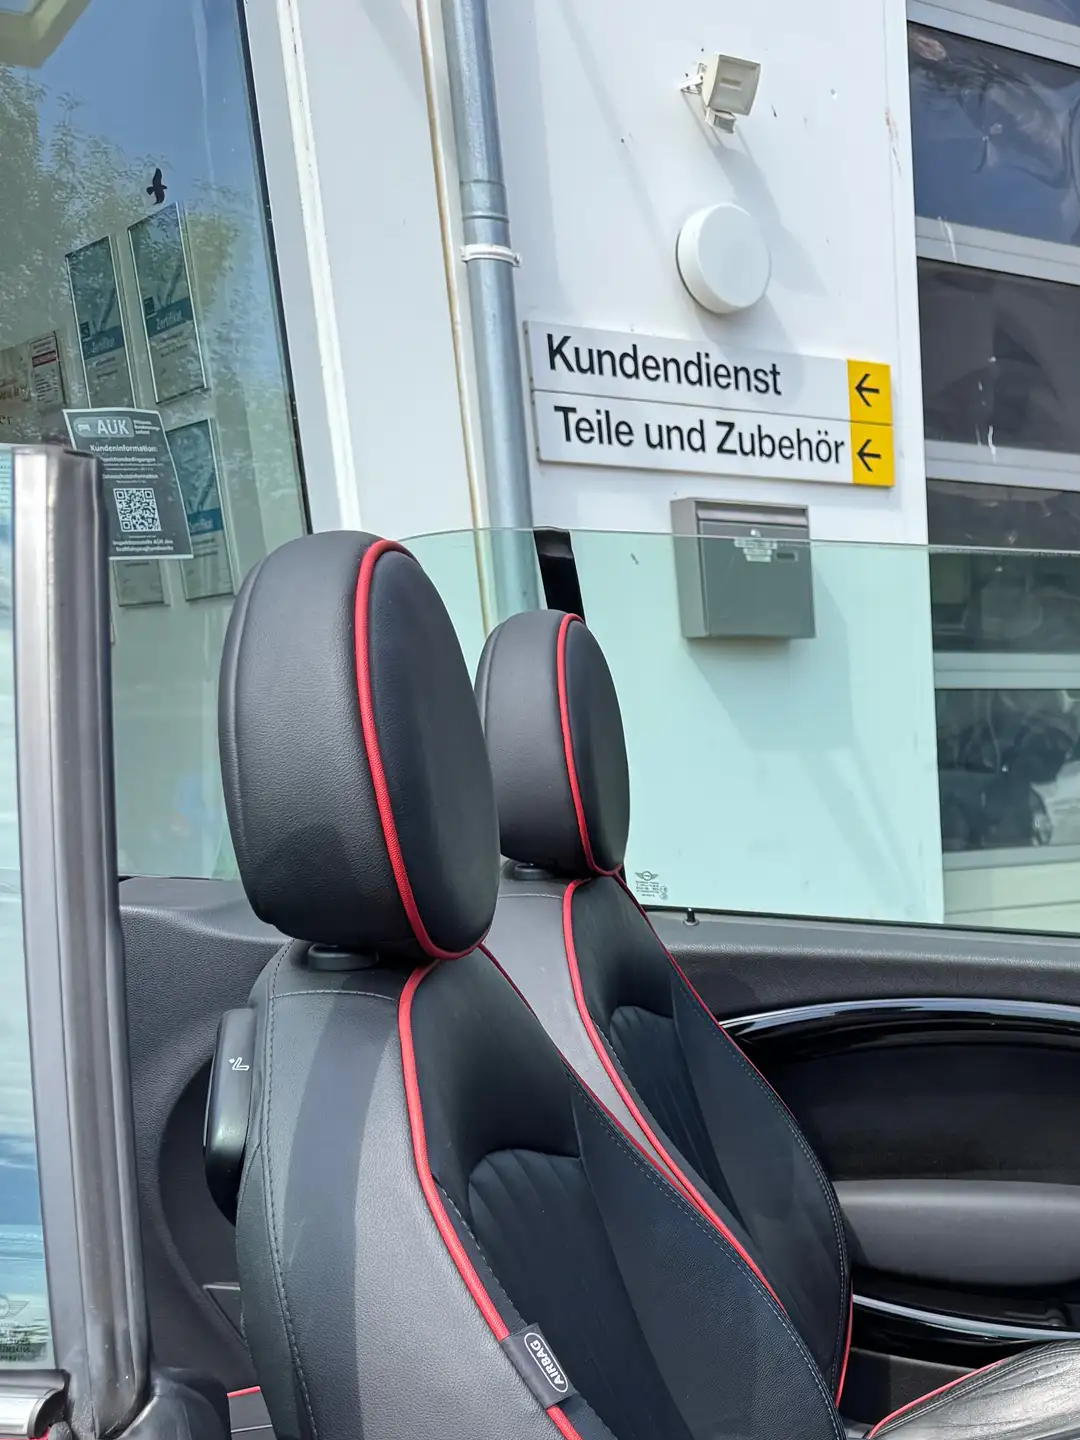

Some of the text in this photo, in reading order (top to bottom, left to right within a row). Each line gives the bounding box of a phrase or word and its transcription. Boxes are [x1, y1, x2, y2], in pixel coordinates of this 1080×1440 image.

[547, 333, 783, 396] Kundendienst
[554, 405, 846, 465] Teile und Zubehör
[530, 1340, 565, 1385] AIRBAG
